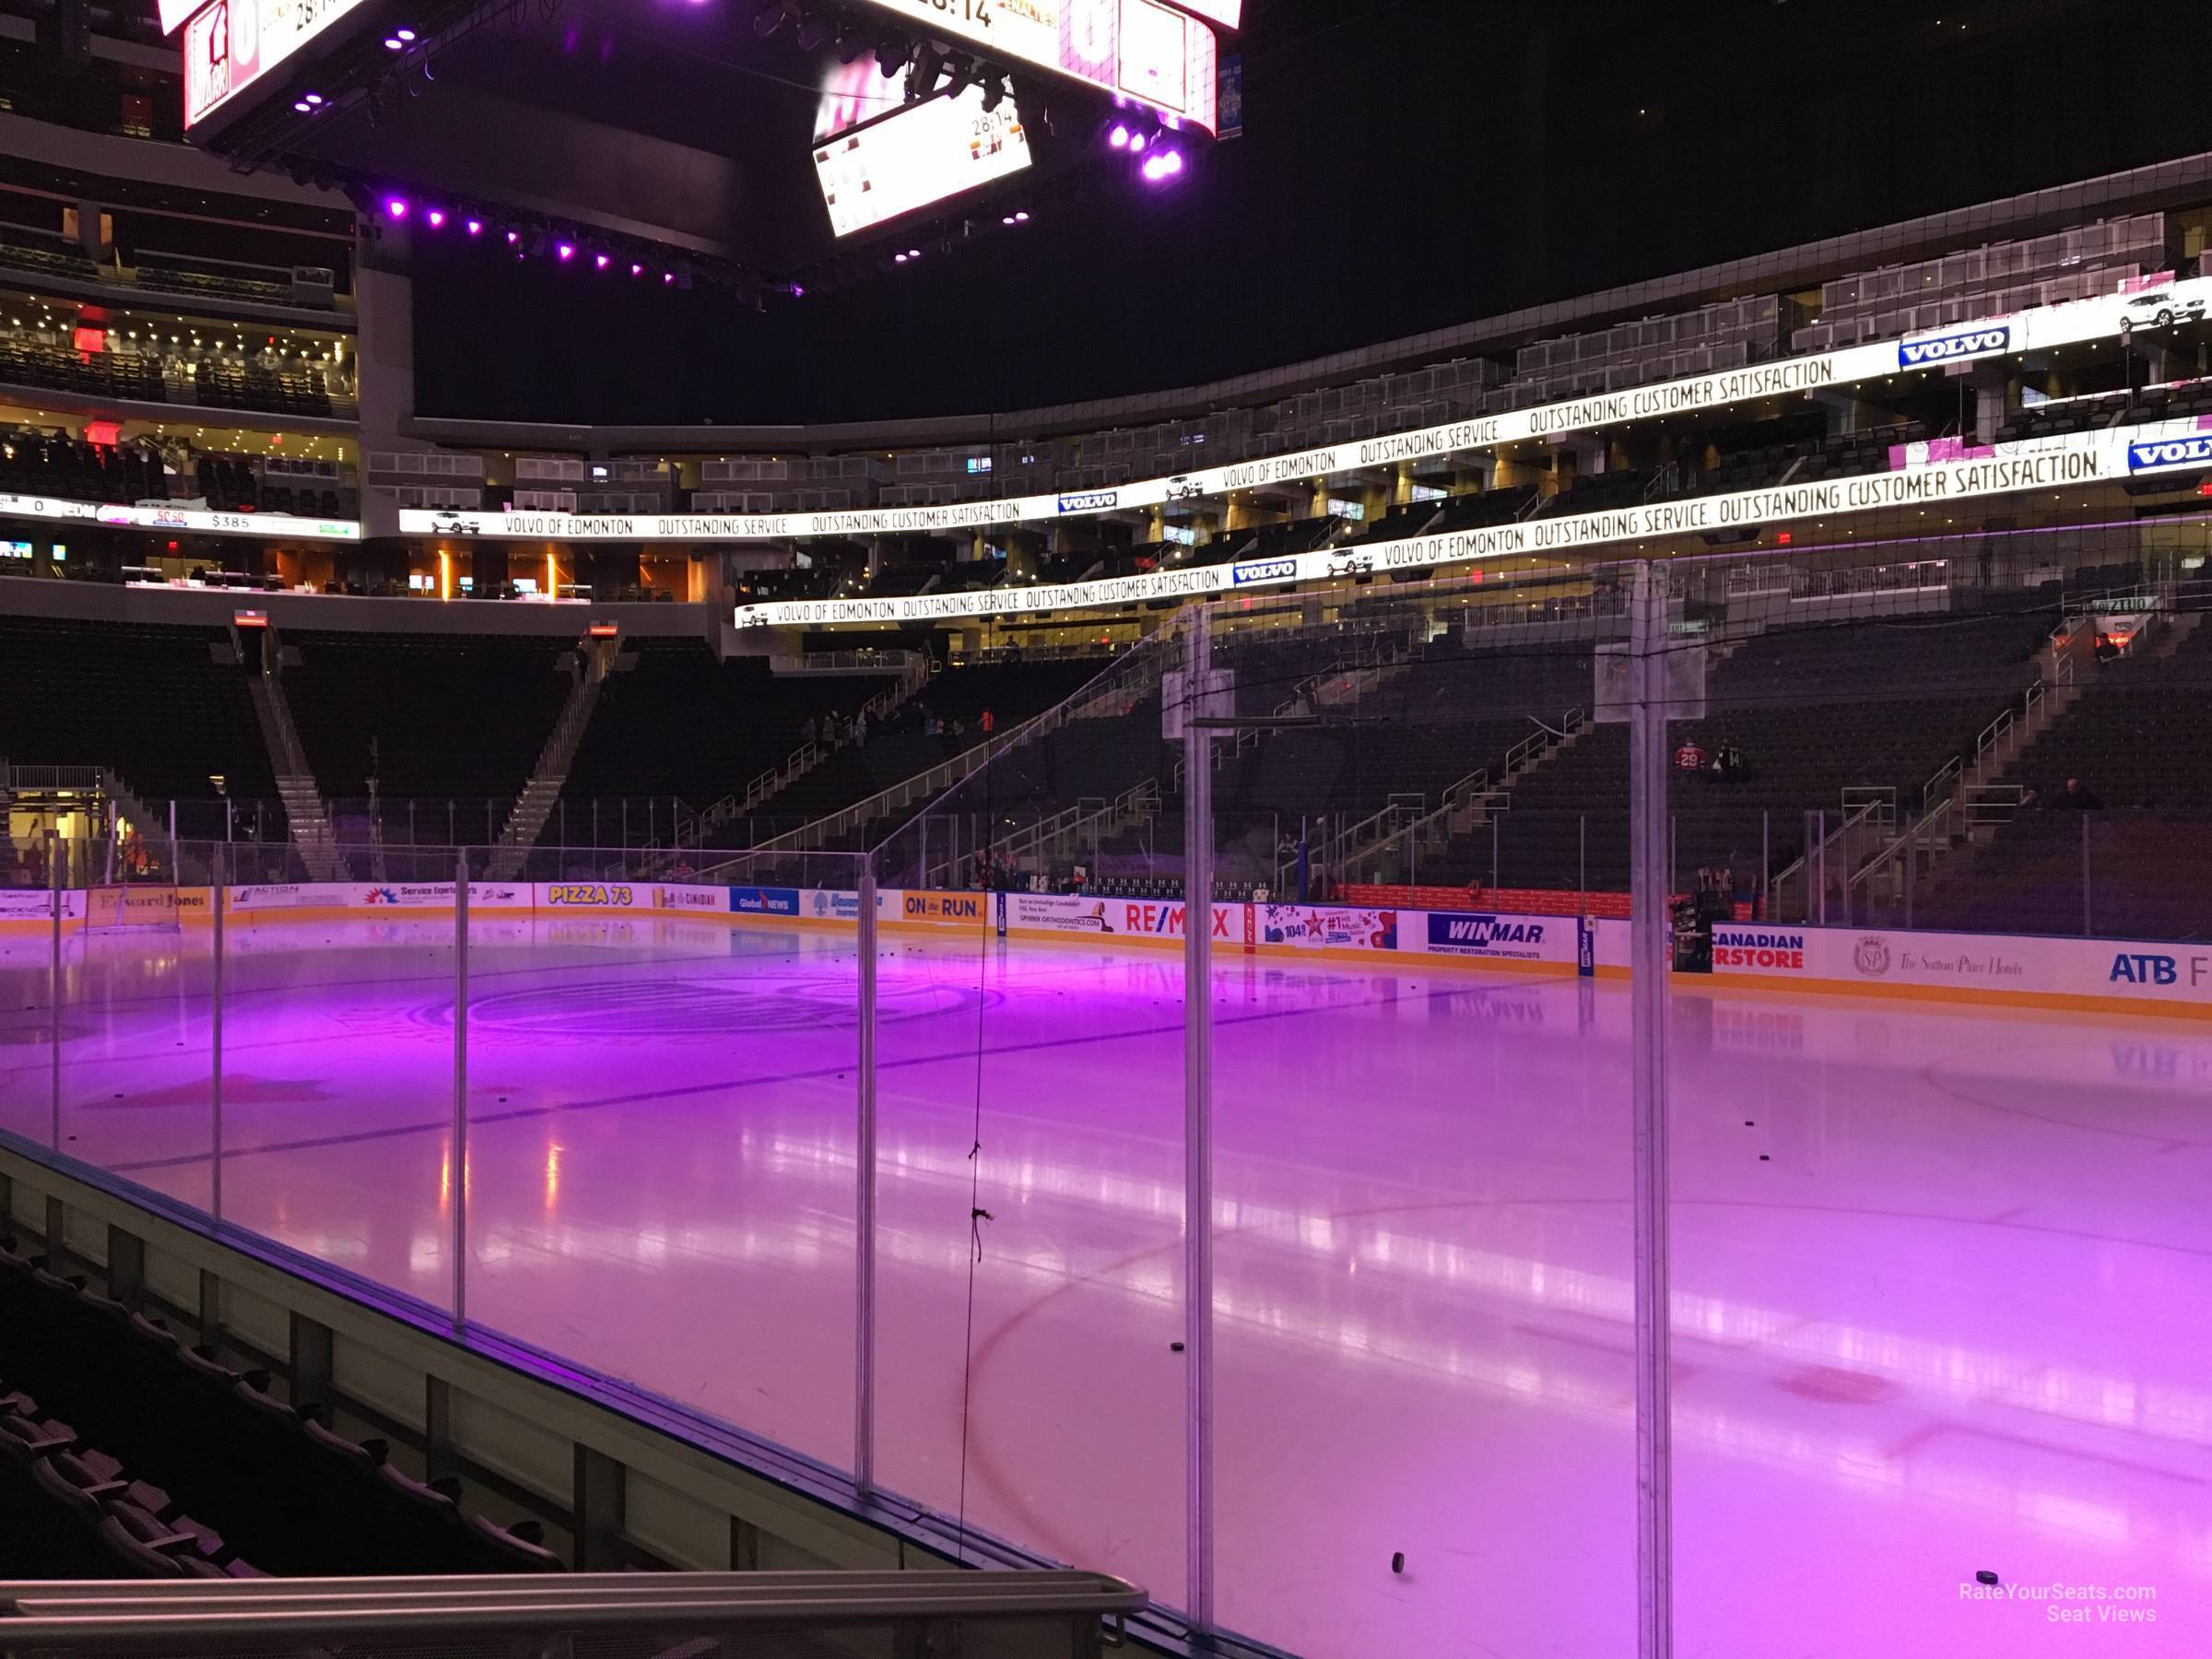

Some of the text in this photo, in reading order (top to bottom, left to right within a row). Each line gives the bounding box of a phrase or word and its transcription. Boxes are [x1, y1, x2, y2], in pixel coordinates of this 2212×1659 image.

[972, 110, 1012, 135] 28:14
[1901, 331, 2006, 363] VOLVO
[1530, 359, 1837, 433] OUTSTANDING CUSTOMER SATISFACTION.
[1359, 434, 1443, 464] OUTSTANDING
[1223, 451, 1336, 488] VOLVO OF EDMONTON
[1720, 451, 2103, 524] OUTSTANDING CUSTOMER SATISFACTION.
[1062, 494, 1116, 511] VOLVO
[212, 515, 250, 528] $385
[505, 517, 633, 535] VOLVO OF EDMONTON
[658, 518, 788, 535] OUTSTANDING SERVICE
[812, 503, 1020, 532] OUTSTANDING CUSTOMER SATISFACTION
[1535, 502, 1712, 546] OUTSTANDING SERVICE.
[1385, 530, 1524, 565] VOLVO OF EDMONTON
[1235, 561, 1295, 583] VOLVO
[1026, 570, 1219, 607] OUTSTANDING CUSTOMER SATISFACTION
[777, 602, 894, 621] VOLVO OF EDMONTON
[904, 592, 1018, 618] OUTSTANDING SERVICE
[1681, 754, 1698, 767] 29
[101, 893, 204, 908] Eward Jones
[401, 887, 432, 895] Service
[548, 885, 632, 905] PIZZA 73
[739, 898, 789, 910] Global NEWS
[906, 897, 925, 914] ON
[942, 899, 976, 917] RUN
[1126, 904, 1229, 936] RE/MX
[1327, 916, 1341, 930] #1
[1449, 921, 1544, 944] WINMAR
[1428, 946, 1540, 959] PROPERTY RESTORATION SPECIALISTS
[1900, 953, 2023, 975] The Sutton Place Hotels
[2110, 953, 2177, 984] ATB
